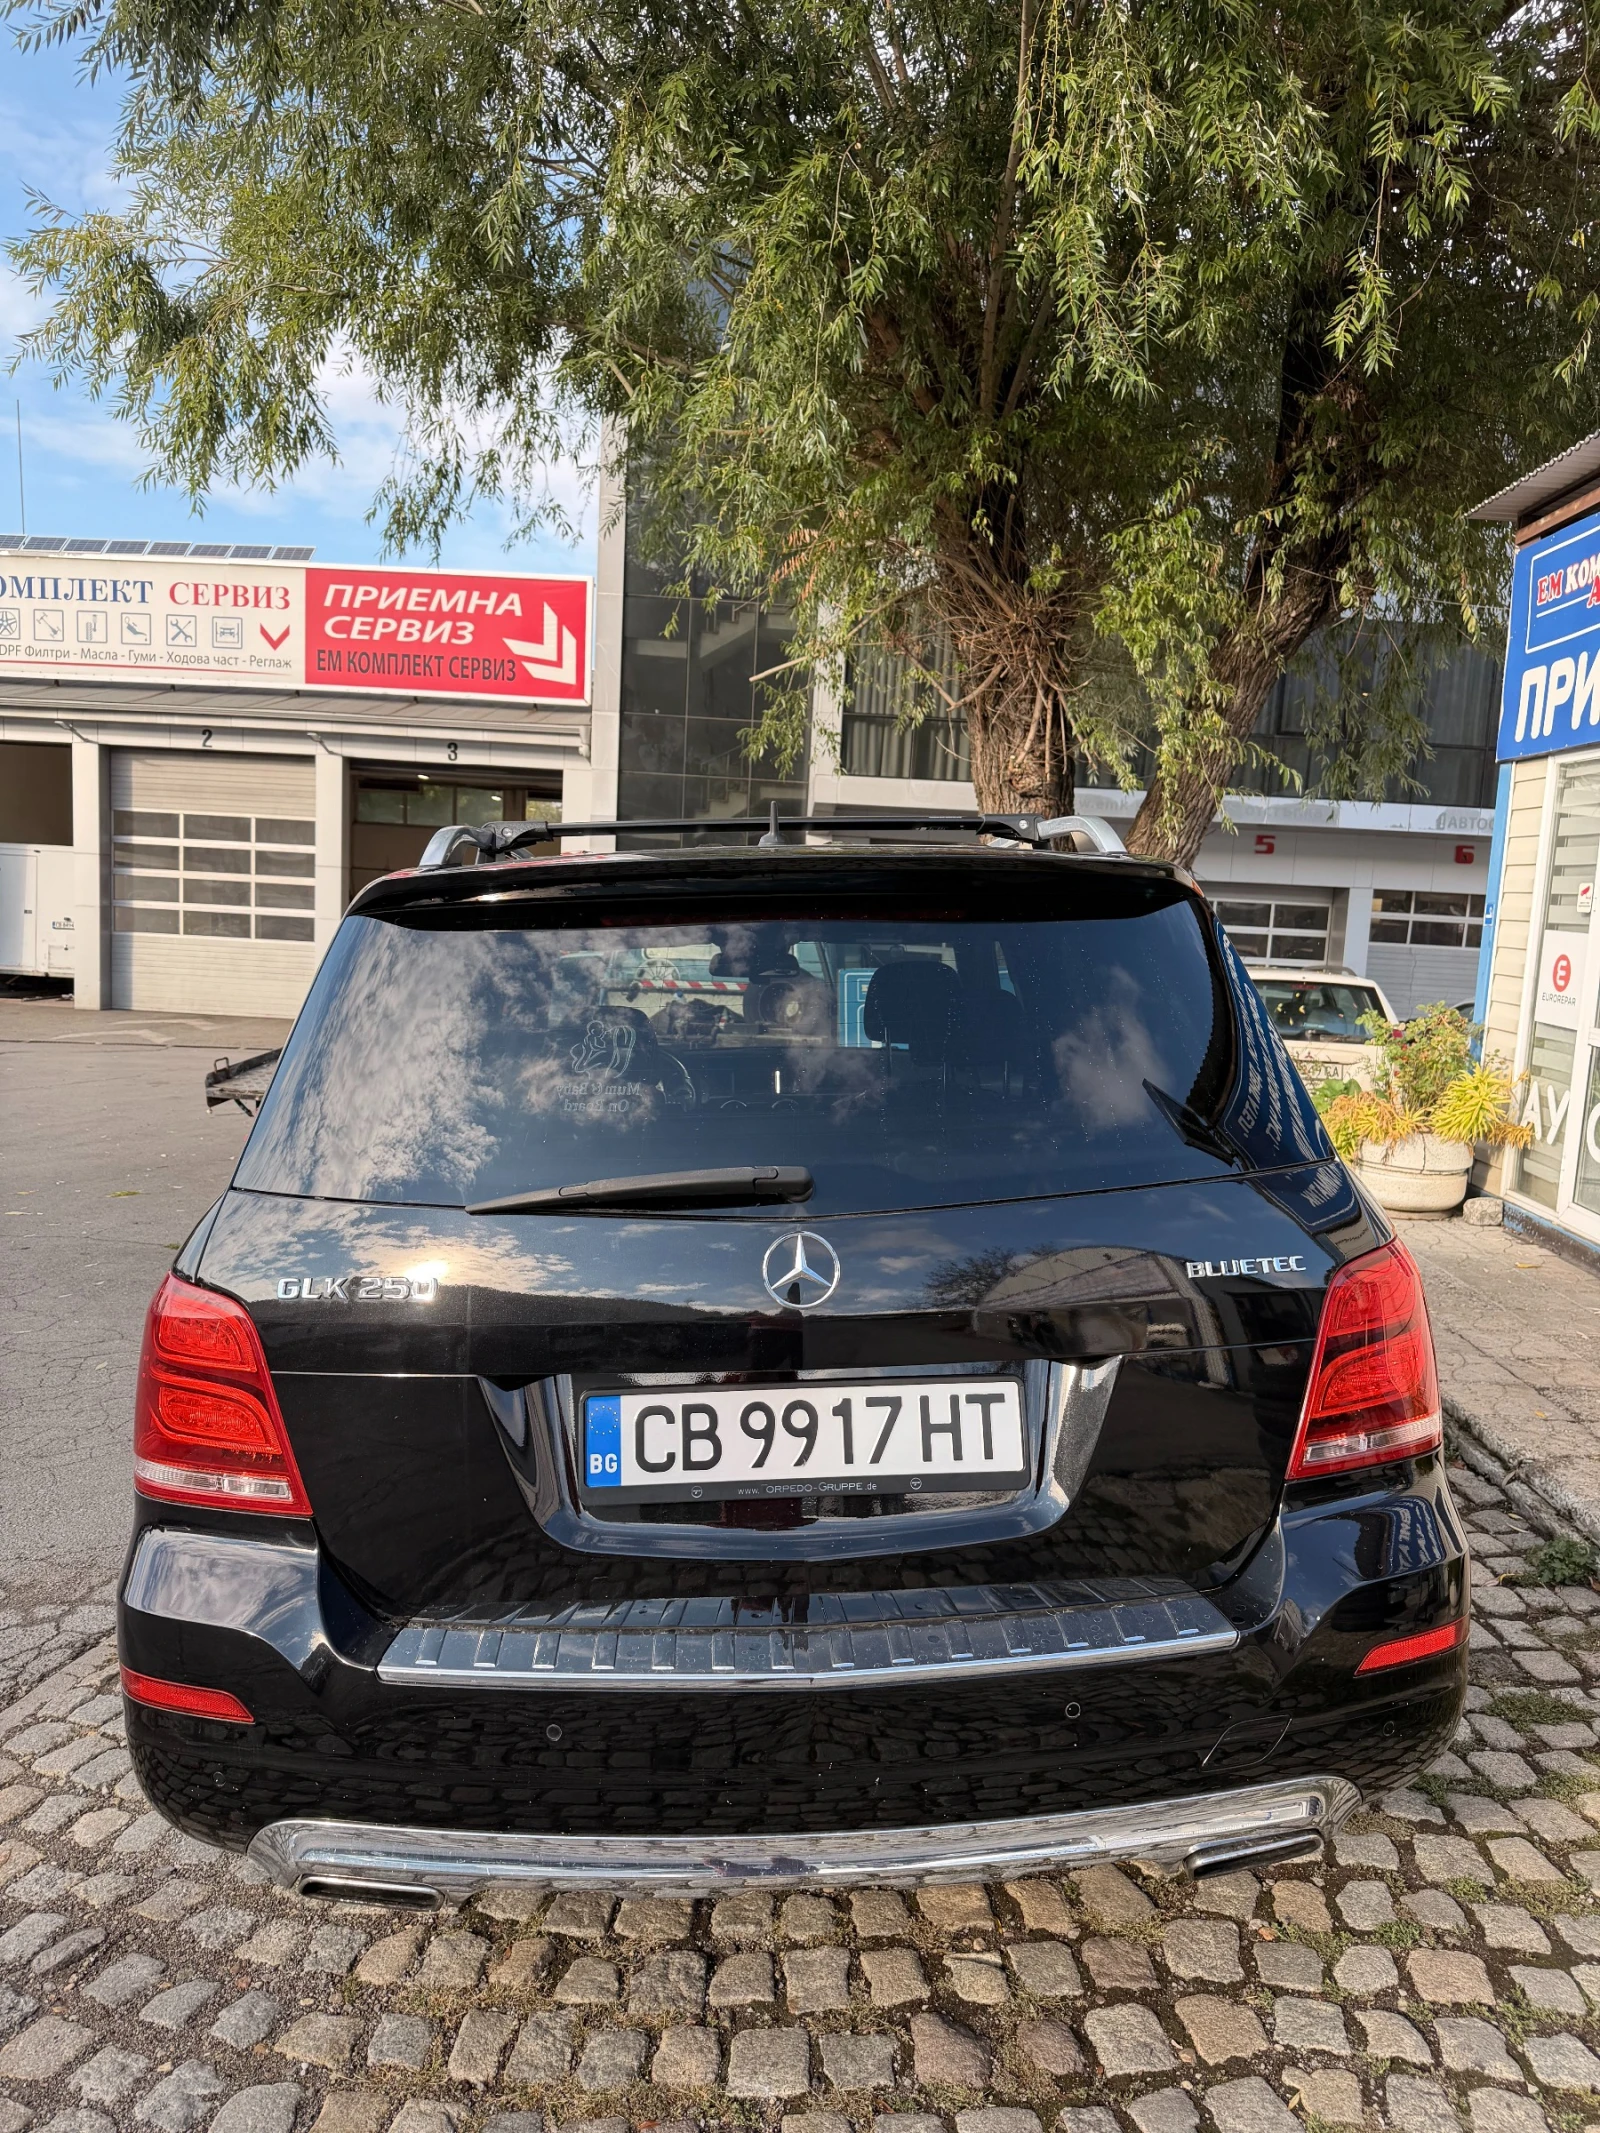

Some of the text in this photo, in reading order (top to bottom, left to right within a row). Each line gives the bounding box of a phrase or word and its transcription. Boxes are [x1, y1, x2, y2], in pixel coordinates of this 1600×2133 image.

[169, 581, 290, 610] СЕРВИЗ
[1537, 569, 1563, 606] ЕМ
[324, 584, 522, 616] ПРИЕМНА
[324, 615, 475, 645] СЕРВИЗ
[24, 645, 70, 661] Филтри
[81, 648, 118, 661] Масла
[128, 649, 156, 665] Гуми
[167, 651, 210, 666] Ходова
[213, 655, 239, 666] част
[250, 654, 292, 669] Реглаж
[317, 649, 516, 681] ЕМ КОМПЛЕКТ СЕРВИЗ
[202, 729, 213, 748] 2
[447, 742, 458, 761] 3
[1255, 835, 1276, 854] 5
[1454, 845, 1475, 864] 6
[1542, 992, 1576, 1006] EUROREPAR
[1186, 1256, 1307, 1279] BLUETEC
[277, 1276, 439, 1300] GLK 250
[634, 1393, 1006, 1473] CB 9917 HT
[589, 1454, 618, 1475] BG
